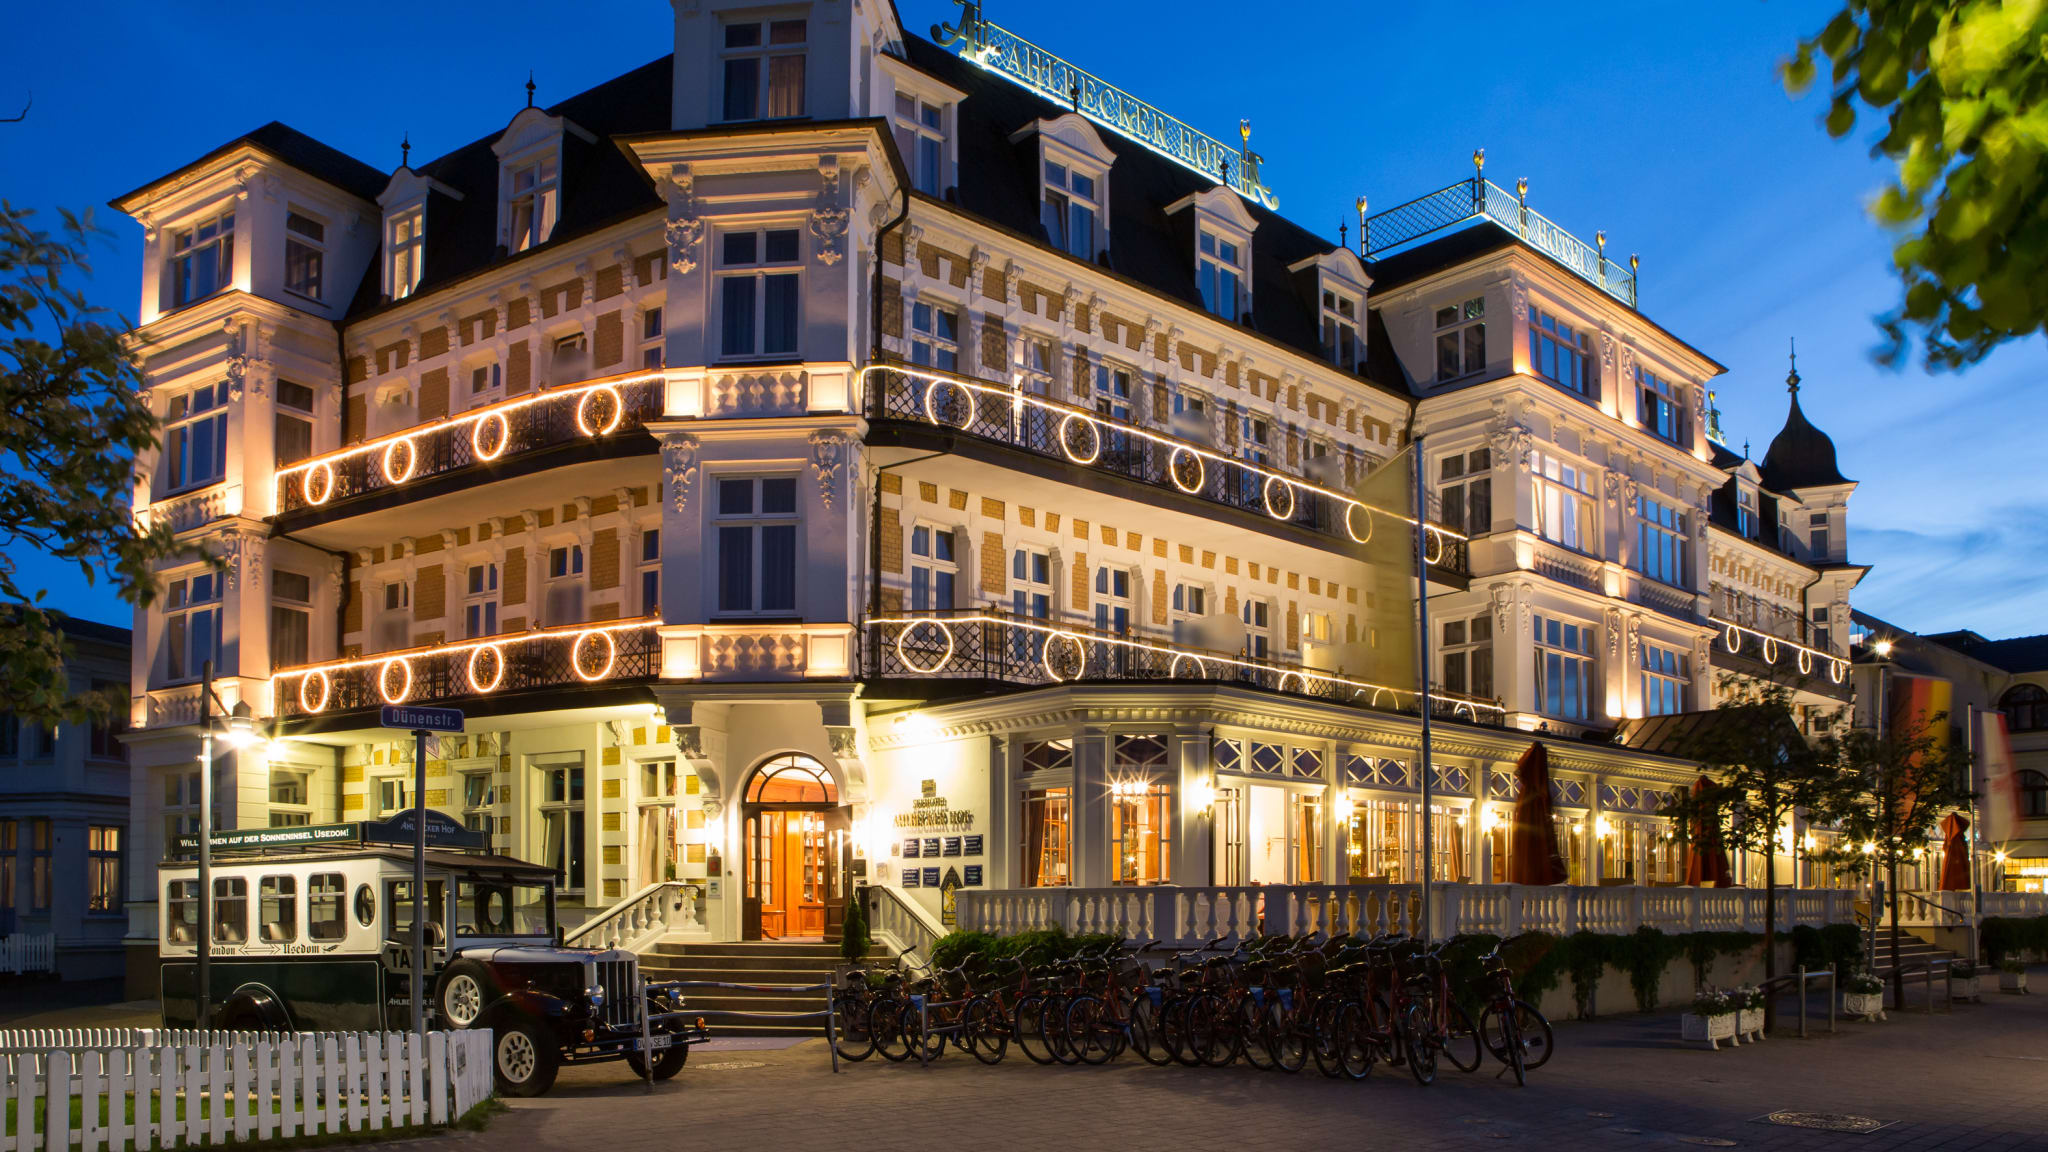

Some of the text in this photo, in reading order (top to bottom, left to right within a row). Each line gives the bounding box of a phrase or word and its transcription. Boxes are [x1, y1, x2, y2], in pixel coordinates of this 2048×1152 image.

[1005, 42, 1169, 150] AHLBECKER
[392, 709, 455, 726] Dünenstr.
[244, 835, 259, 843] DER
[260, 832, 312, 842] SONNENINSEL
[314, 828, 349, 838] USEDOM!
[401, 822, 456, 834] AHLCKER HOF
[209, 943, 320, 955] ondon Usedom
[390, 948, 427, 970] TAI
